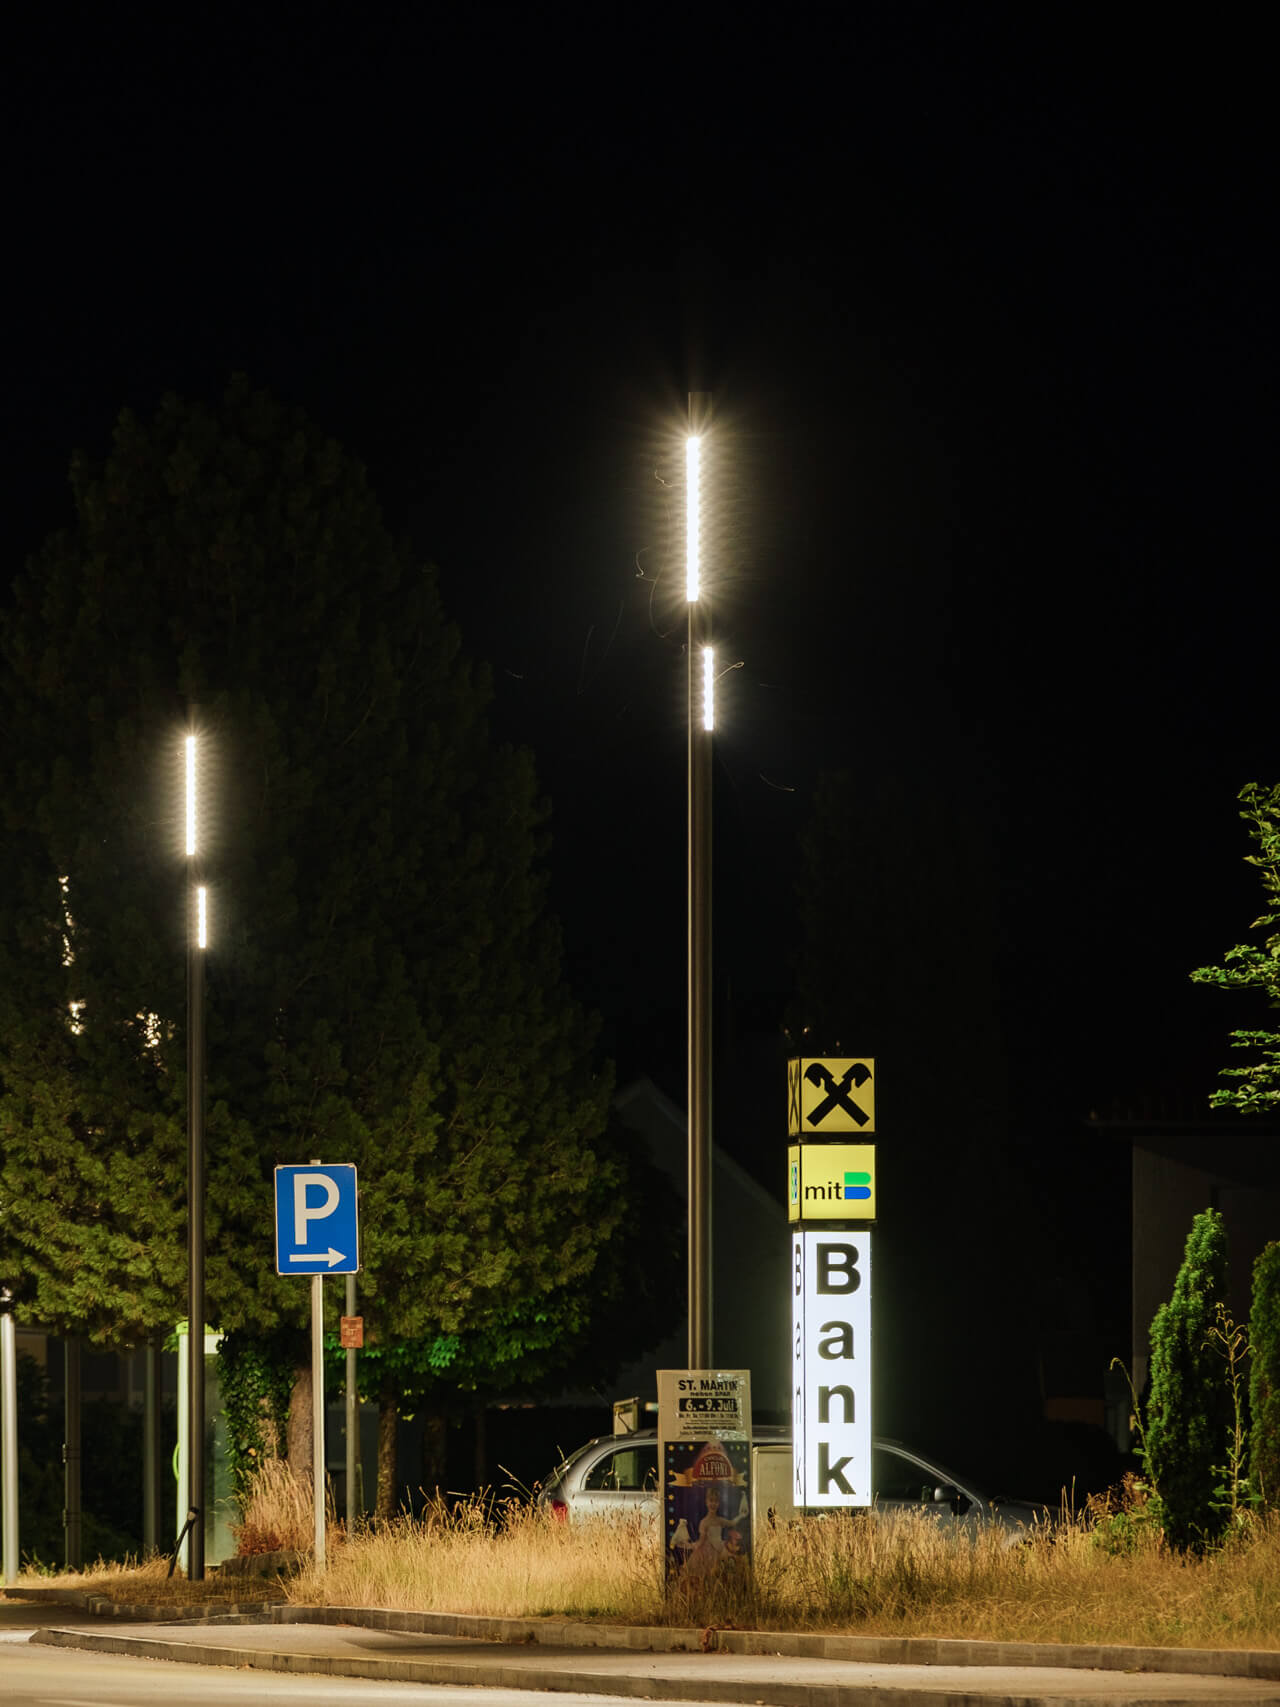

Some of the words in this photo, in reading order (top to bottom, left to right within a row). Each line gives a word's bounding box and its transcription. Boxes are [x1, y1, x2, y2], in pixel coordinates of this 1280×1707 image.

[294, 1173, 340, 1245] P
[678, 1379, 697, 1391] ST.
[700, 1379, 738, 1391] MARTIN
[816, 1242, 862, 1495] Bank
